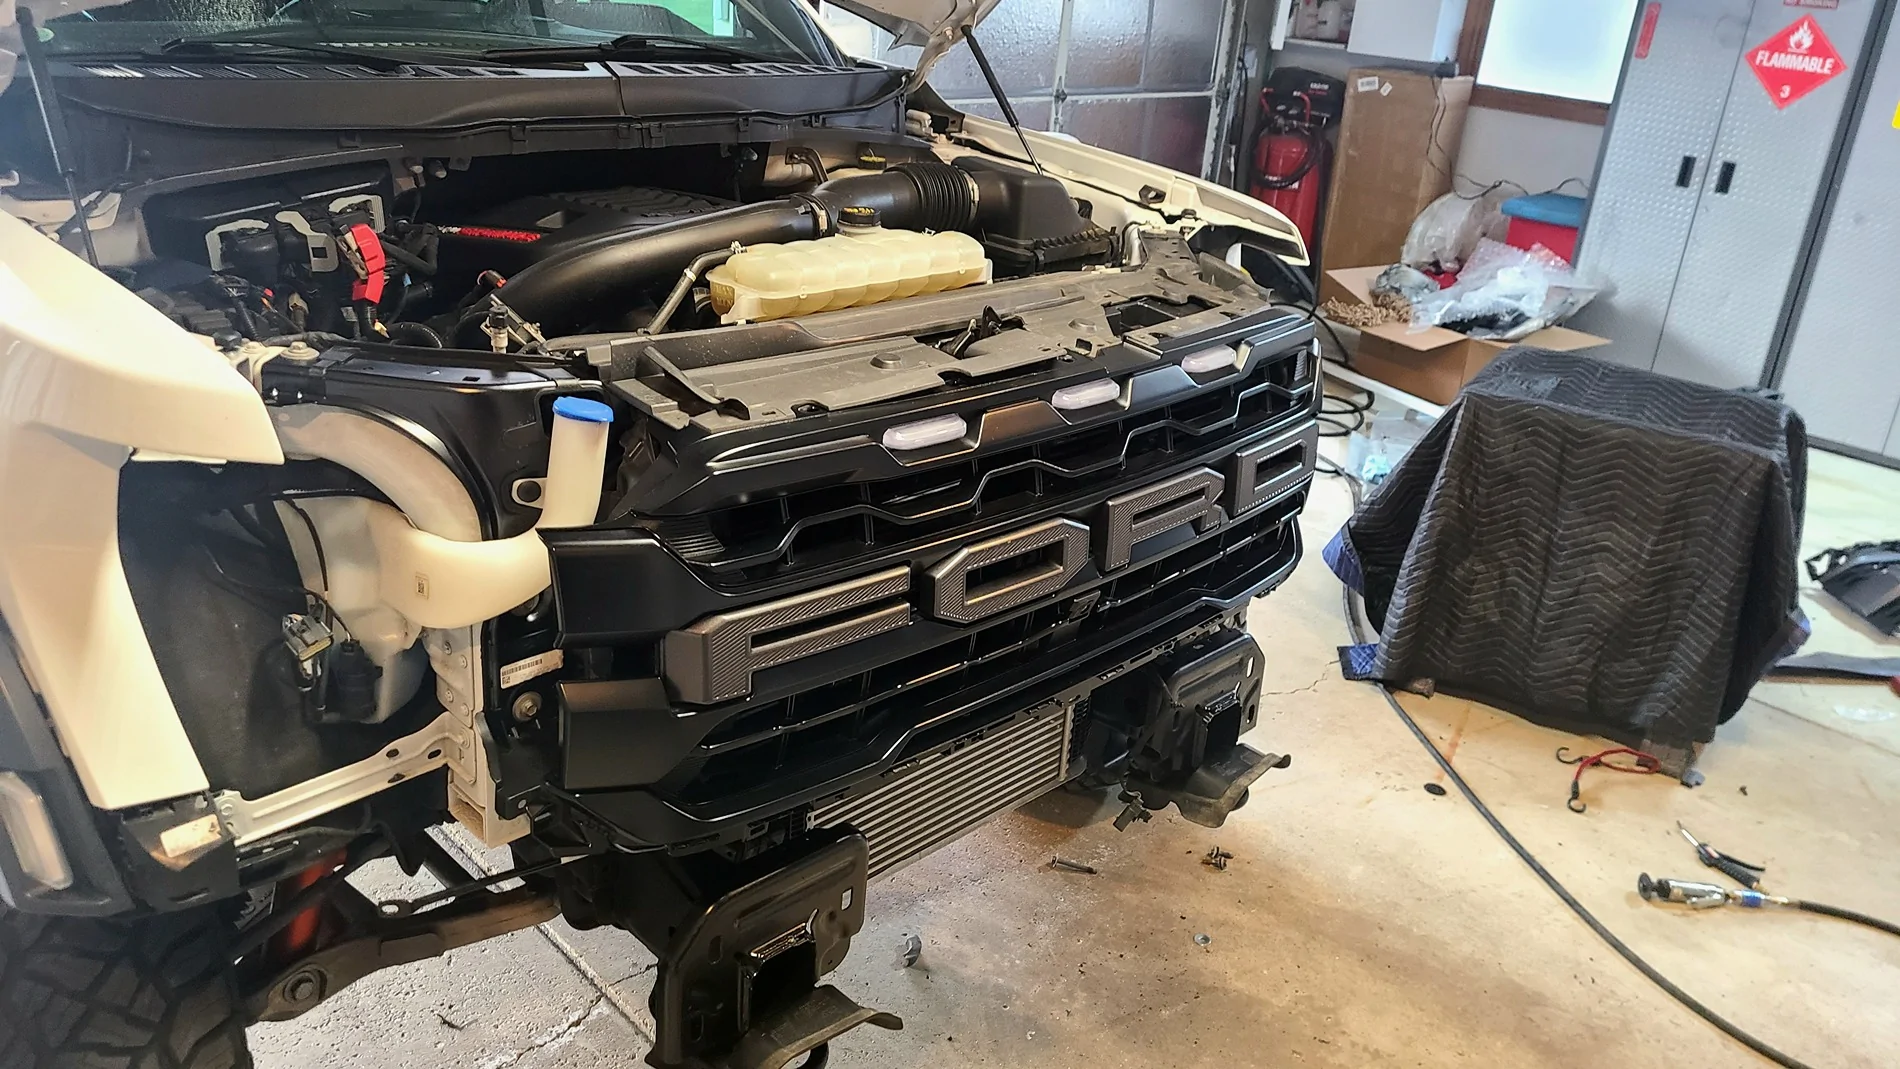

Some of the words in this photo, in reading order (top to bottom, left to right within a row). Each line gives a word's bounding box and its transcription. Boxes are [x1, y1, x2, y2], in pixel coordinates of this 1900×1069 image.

[1755, 50, 1834, 74] FLAMMABLE
[1779, 84, 1791, 98] 3
[661, 421, 1318, 703] FORD
